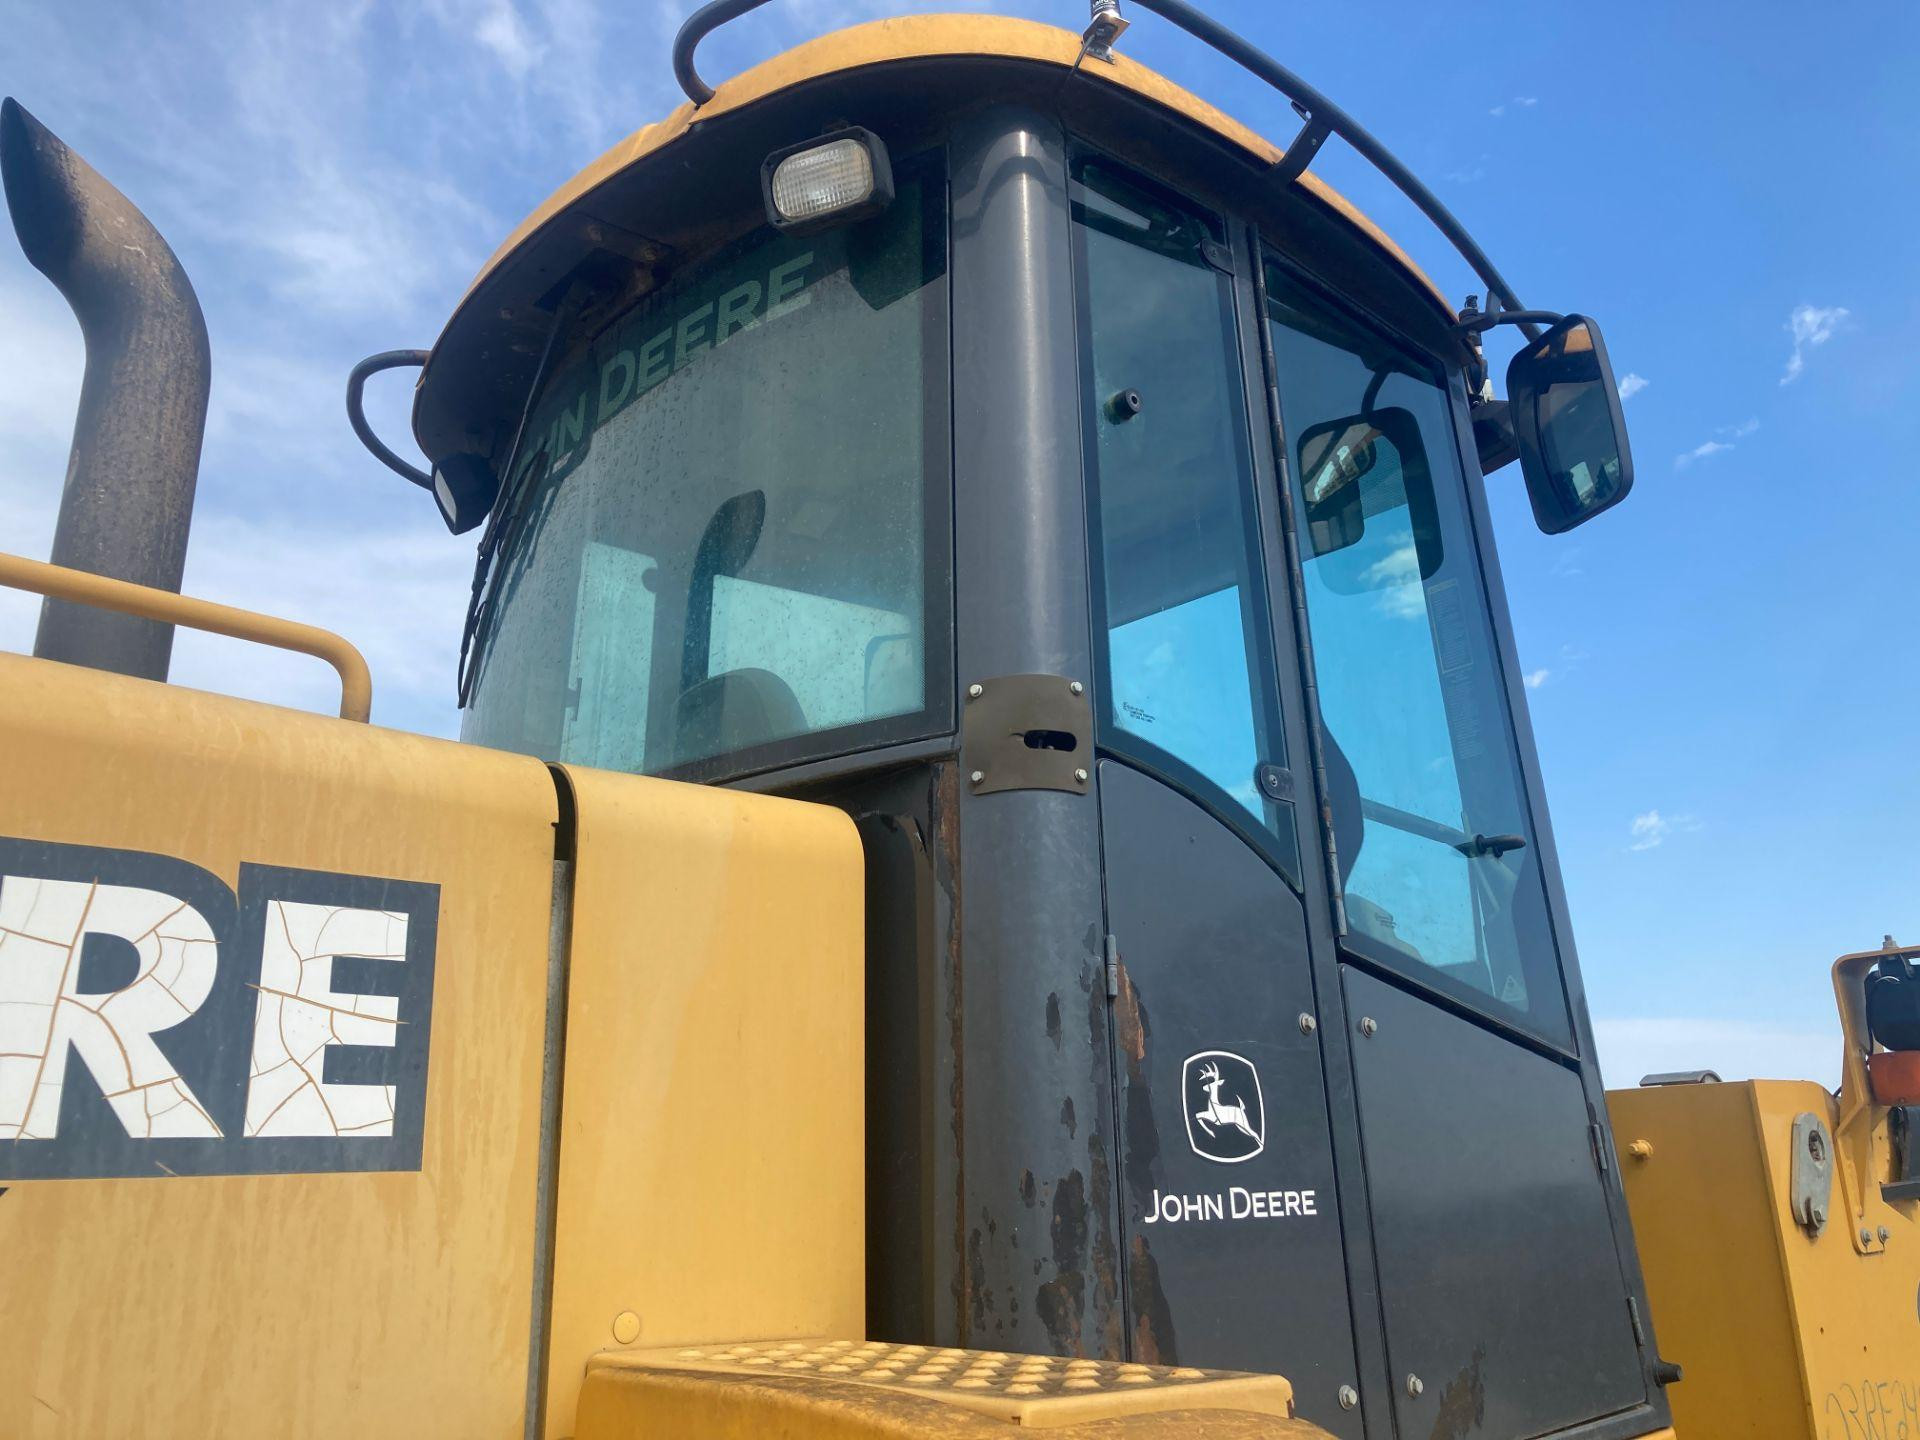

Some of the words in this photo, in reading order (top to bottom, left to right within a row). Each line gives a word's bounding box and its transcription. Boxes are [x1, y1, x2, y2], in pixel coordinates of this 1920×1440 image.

[597, 251, 815, 426] DEERE
[1144, 1189, 1224, 1224] JOHN
[1229, 1186, 1318, 1219] DEERE
